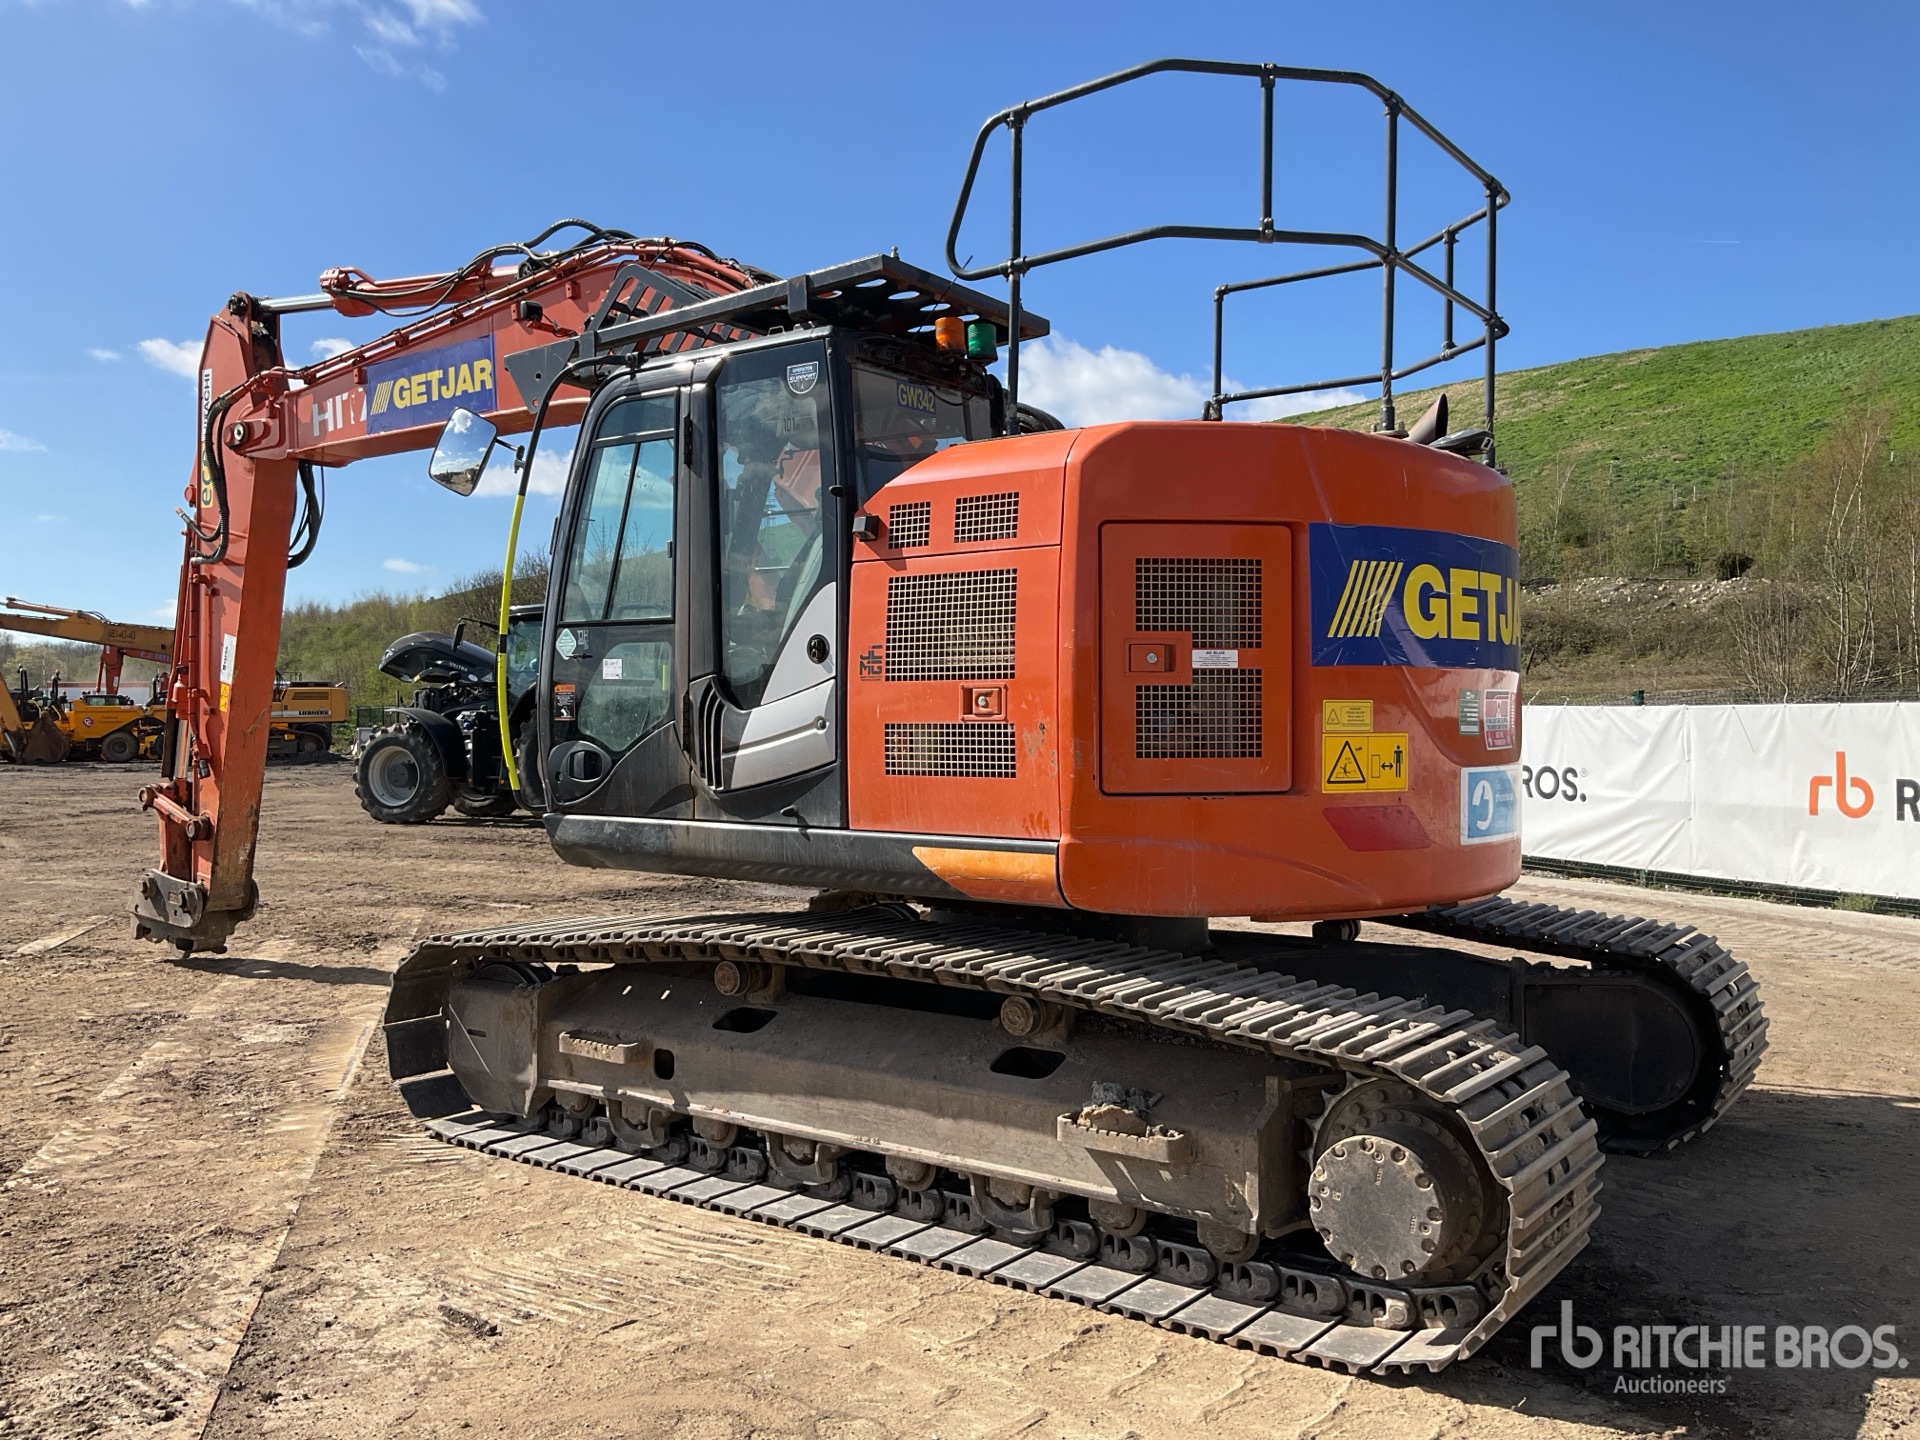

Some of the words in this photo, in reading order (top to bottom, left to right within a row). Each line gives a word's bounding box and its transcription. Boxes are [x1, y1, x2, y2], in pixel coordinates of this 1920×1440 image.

[393, 358, 493, 409] GETJAR
[789, 372, 817, 384] SUPPORT
[898, 383, 935, 413] GW342
[1808, 751, 1875, 819] rb
